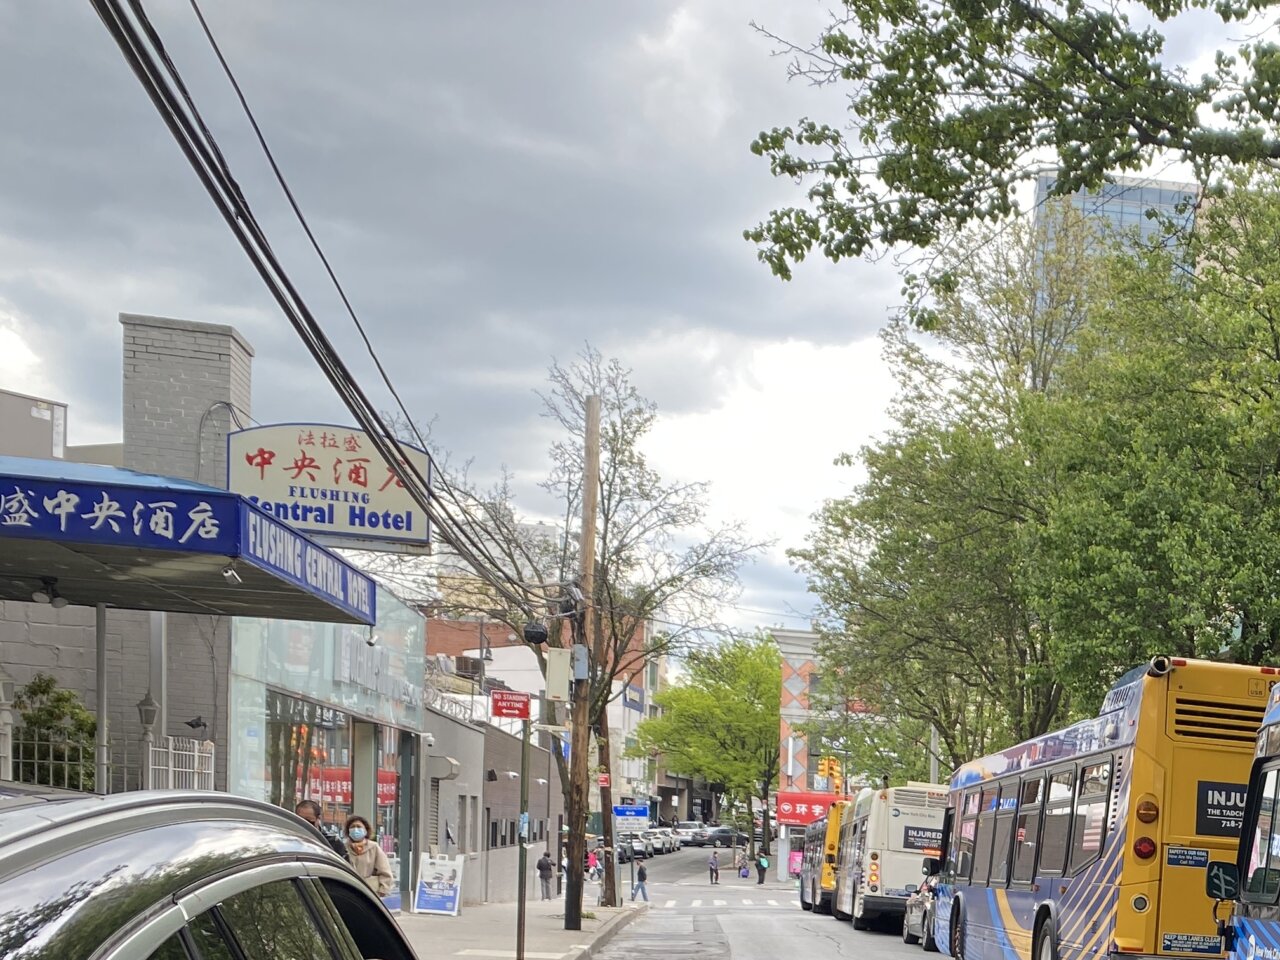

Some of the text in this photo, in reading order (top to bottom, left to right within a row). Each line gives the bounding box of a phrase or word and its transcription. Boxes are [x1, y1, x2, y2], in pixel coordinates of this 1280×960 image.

[297, 429, 362, 452] 法拉盛
[288, 485, 370, 504] FLUSHING
[0, 486, 220, 543] 盛中央酒店
[349, 504, 412, 531] Hotel
[248, 511, 370, 615] FLUSHING CENTRAL HOTEL
[503, 694, 528, 702] STANDING
[1207, 808, 1221, 816] THE
[908, 829, 943, 839] INJURED
[1255, 945, 1264, 957] New
[1264, 946, 1273, 960] York
